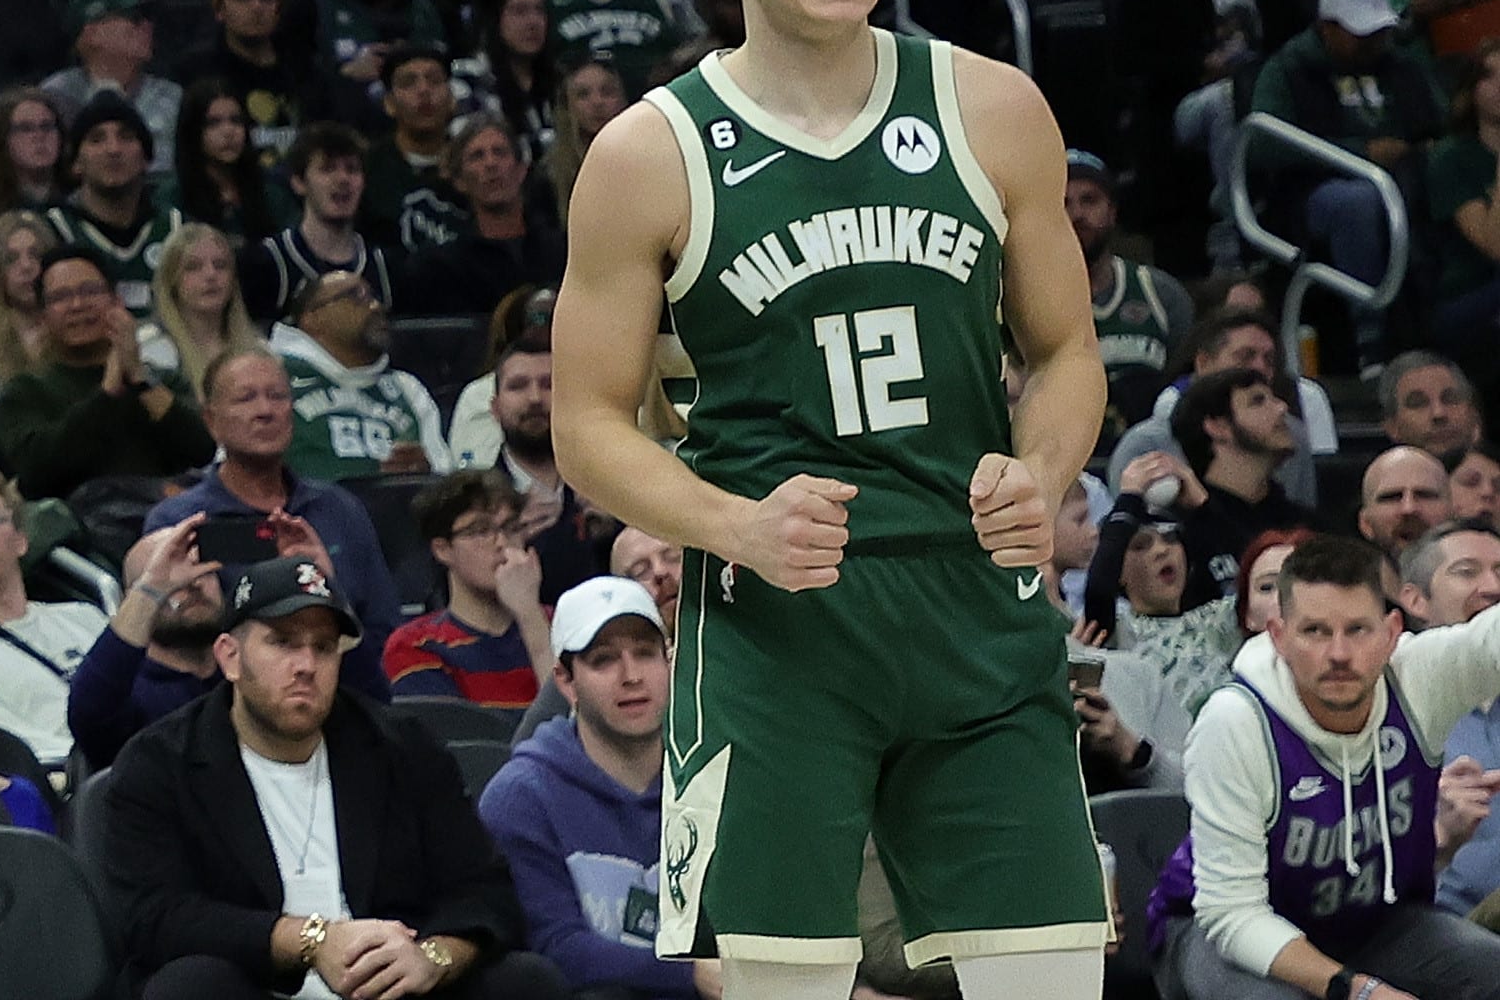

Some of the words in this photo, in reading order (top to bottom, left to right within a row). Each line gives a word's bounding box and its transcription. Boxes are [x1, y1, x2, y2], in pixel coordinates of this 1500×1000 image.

[709, 119, 737, 149] 6
[718, 205, 986, 318] MILWAUKEE
[812, 304, 930, 438] 12
[1282, 774, 1415, 869] BUCKS
[1310, 856, 1381, 918] 34
